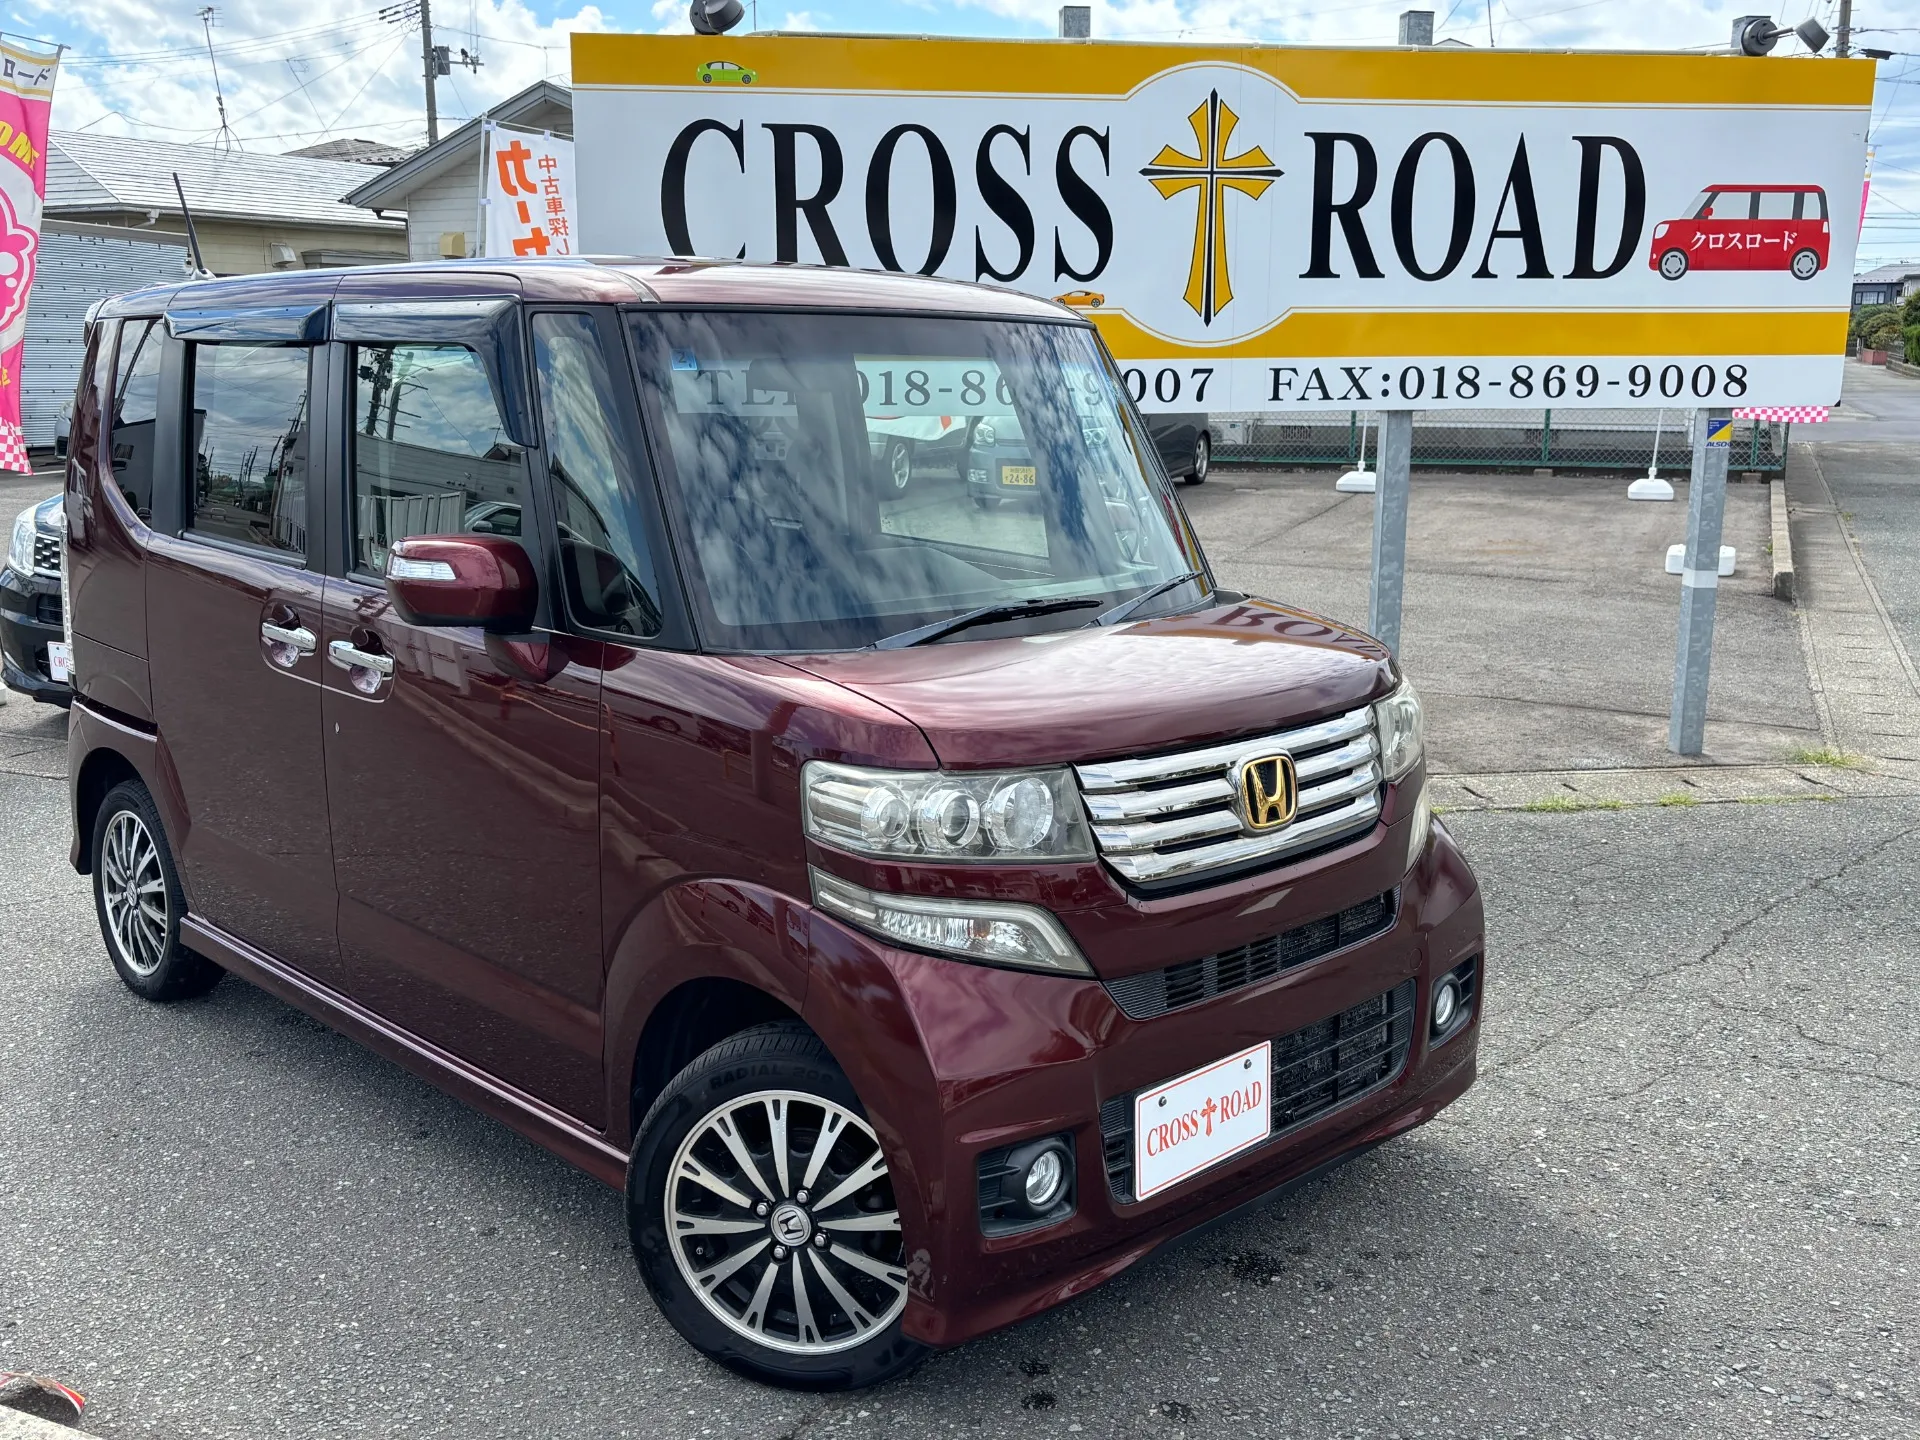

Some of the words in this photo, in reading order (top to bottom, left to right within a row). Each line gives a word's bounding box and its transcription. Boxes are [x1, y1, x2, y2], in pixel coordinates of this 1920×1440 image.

[661, 118, 1115, 283] CROSS
[1299, 131, 1647, 282] ROAD
[1690, 230, 1798, 252] クロスロード
[1268, 364, 1748, 402] FAX:018-869-9008
[1146, 1109, 1199, 1157] CROSS
[1219, 1081, 1262, 1124] ROAD
